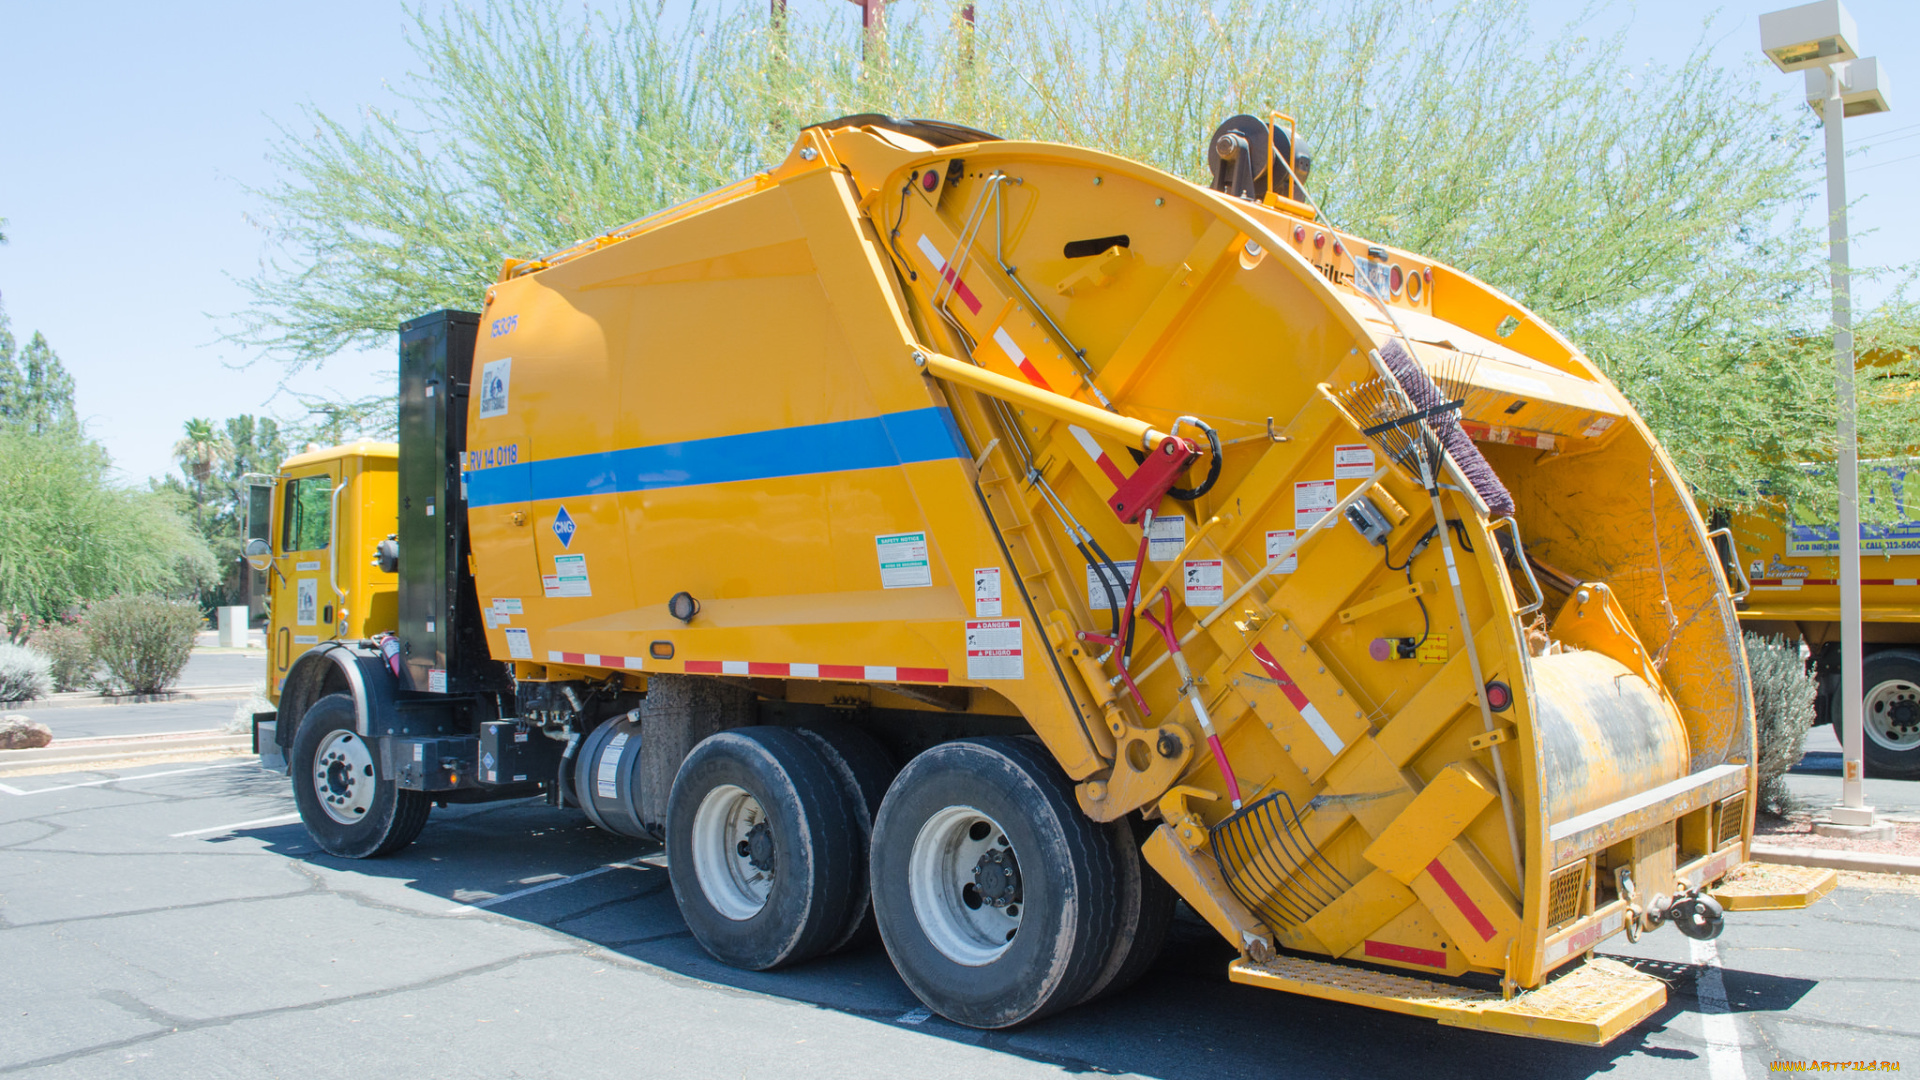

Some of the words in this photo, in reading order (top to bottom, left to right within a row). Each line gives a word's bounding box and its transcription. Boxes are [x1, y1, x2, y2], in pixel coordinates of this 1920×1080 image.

[470, 450, 483, 470] RV
[484, 447, 495, 468] 14
[496, 443, 518, 466] 0118
[554, 521, 574, 533] CNG
[1796, 543, 1810, 551] FOR
[982, 621, 1010, 629] DANGER
